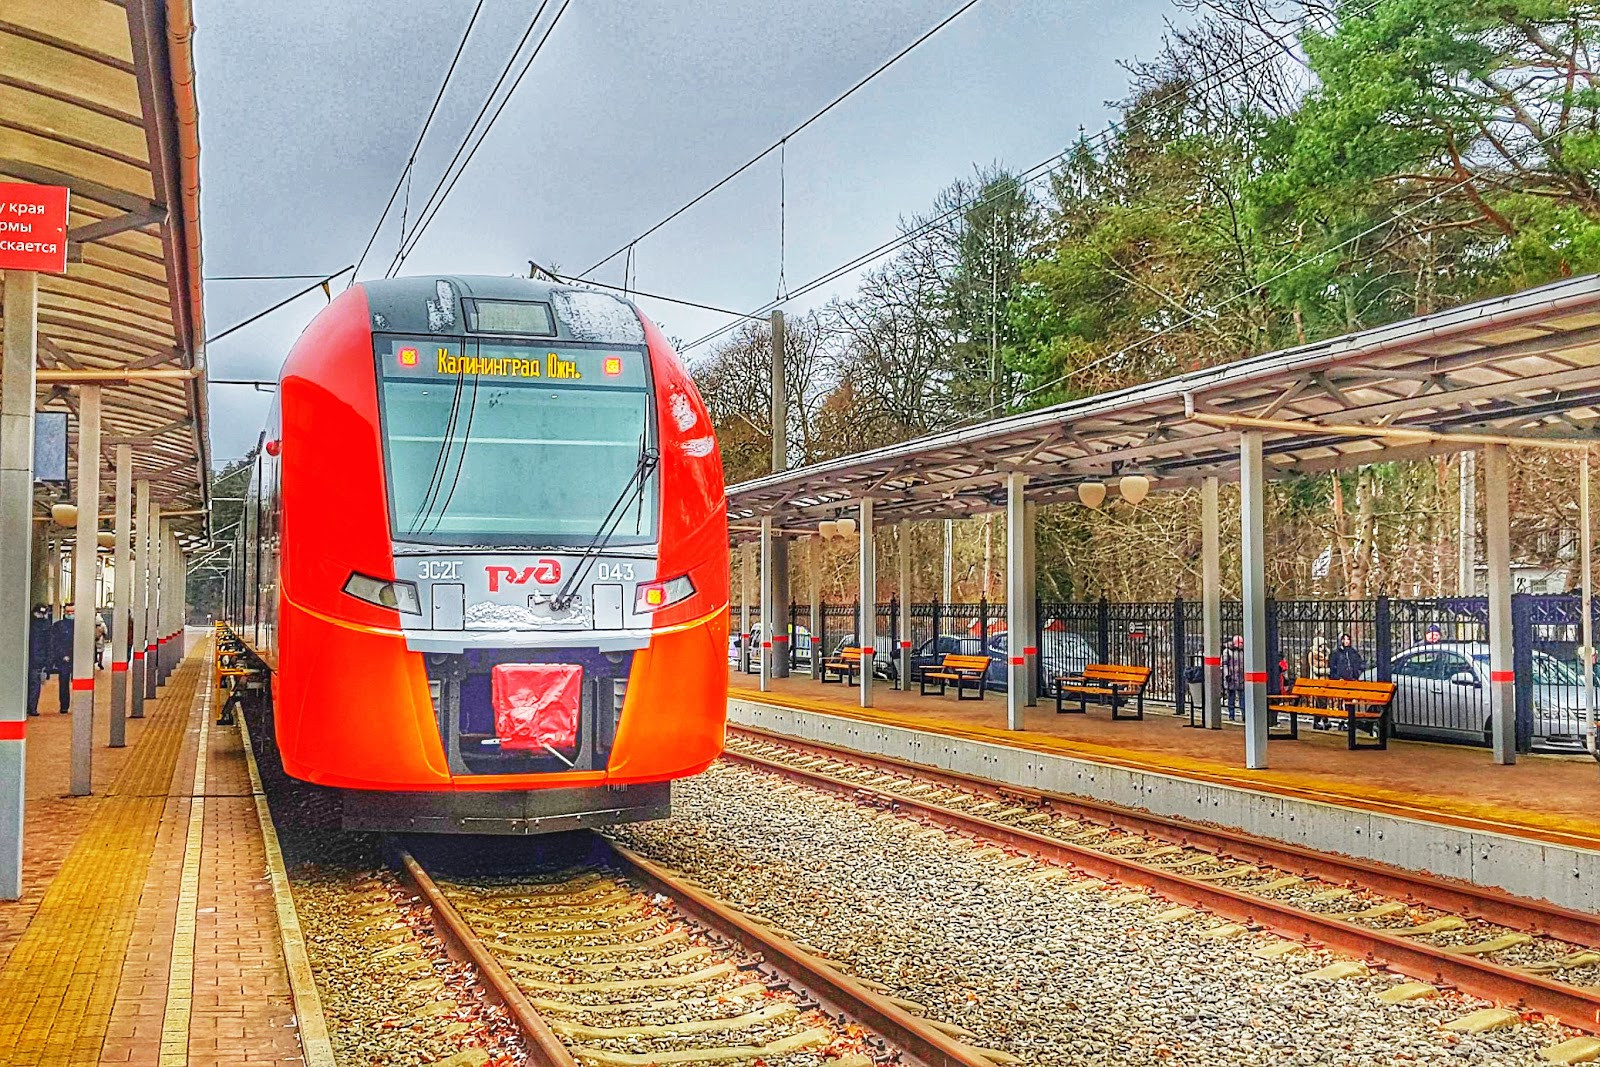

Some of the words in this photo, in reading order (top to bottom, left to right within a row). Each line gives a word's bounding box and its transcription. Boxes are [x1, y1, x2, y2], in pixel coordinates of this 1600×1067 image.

[9, 202, 45, 216] края
[0, 240, 57, 254] скается
[438, 348, 541, 377] Калининград
[547, 352, 582, 379] Южн.
[597, 562, 635, 581] 043
